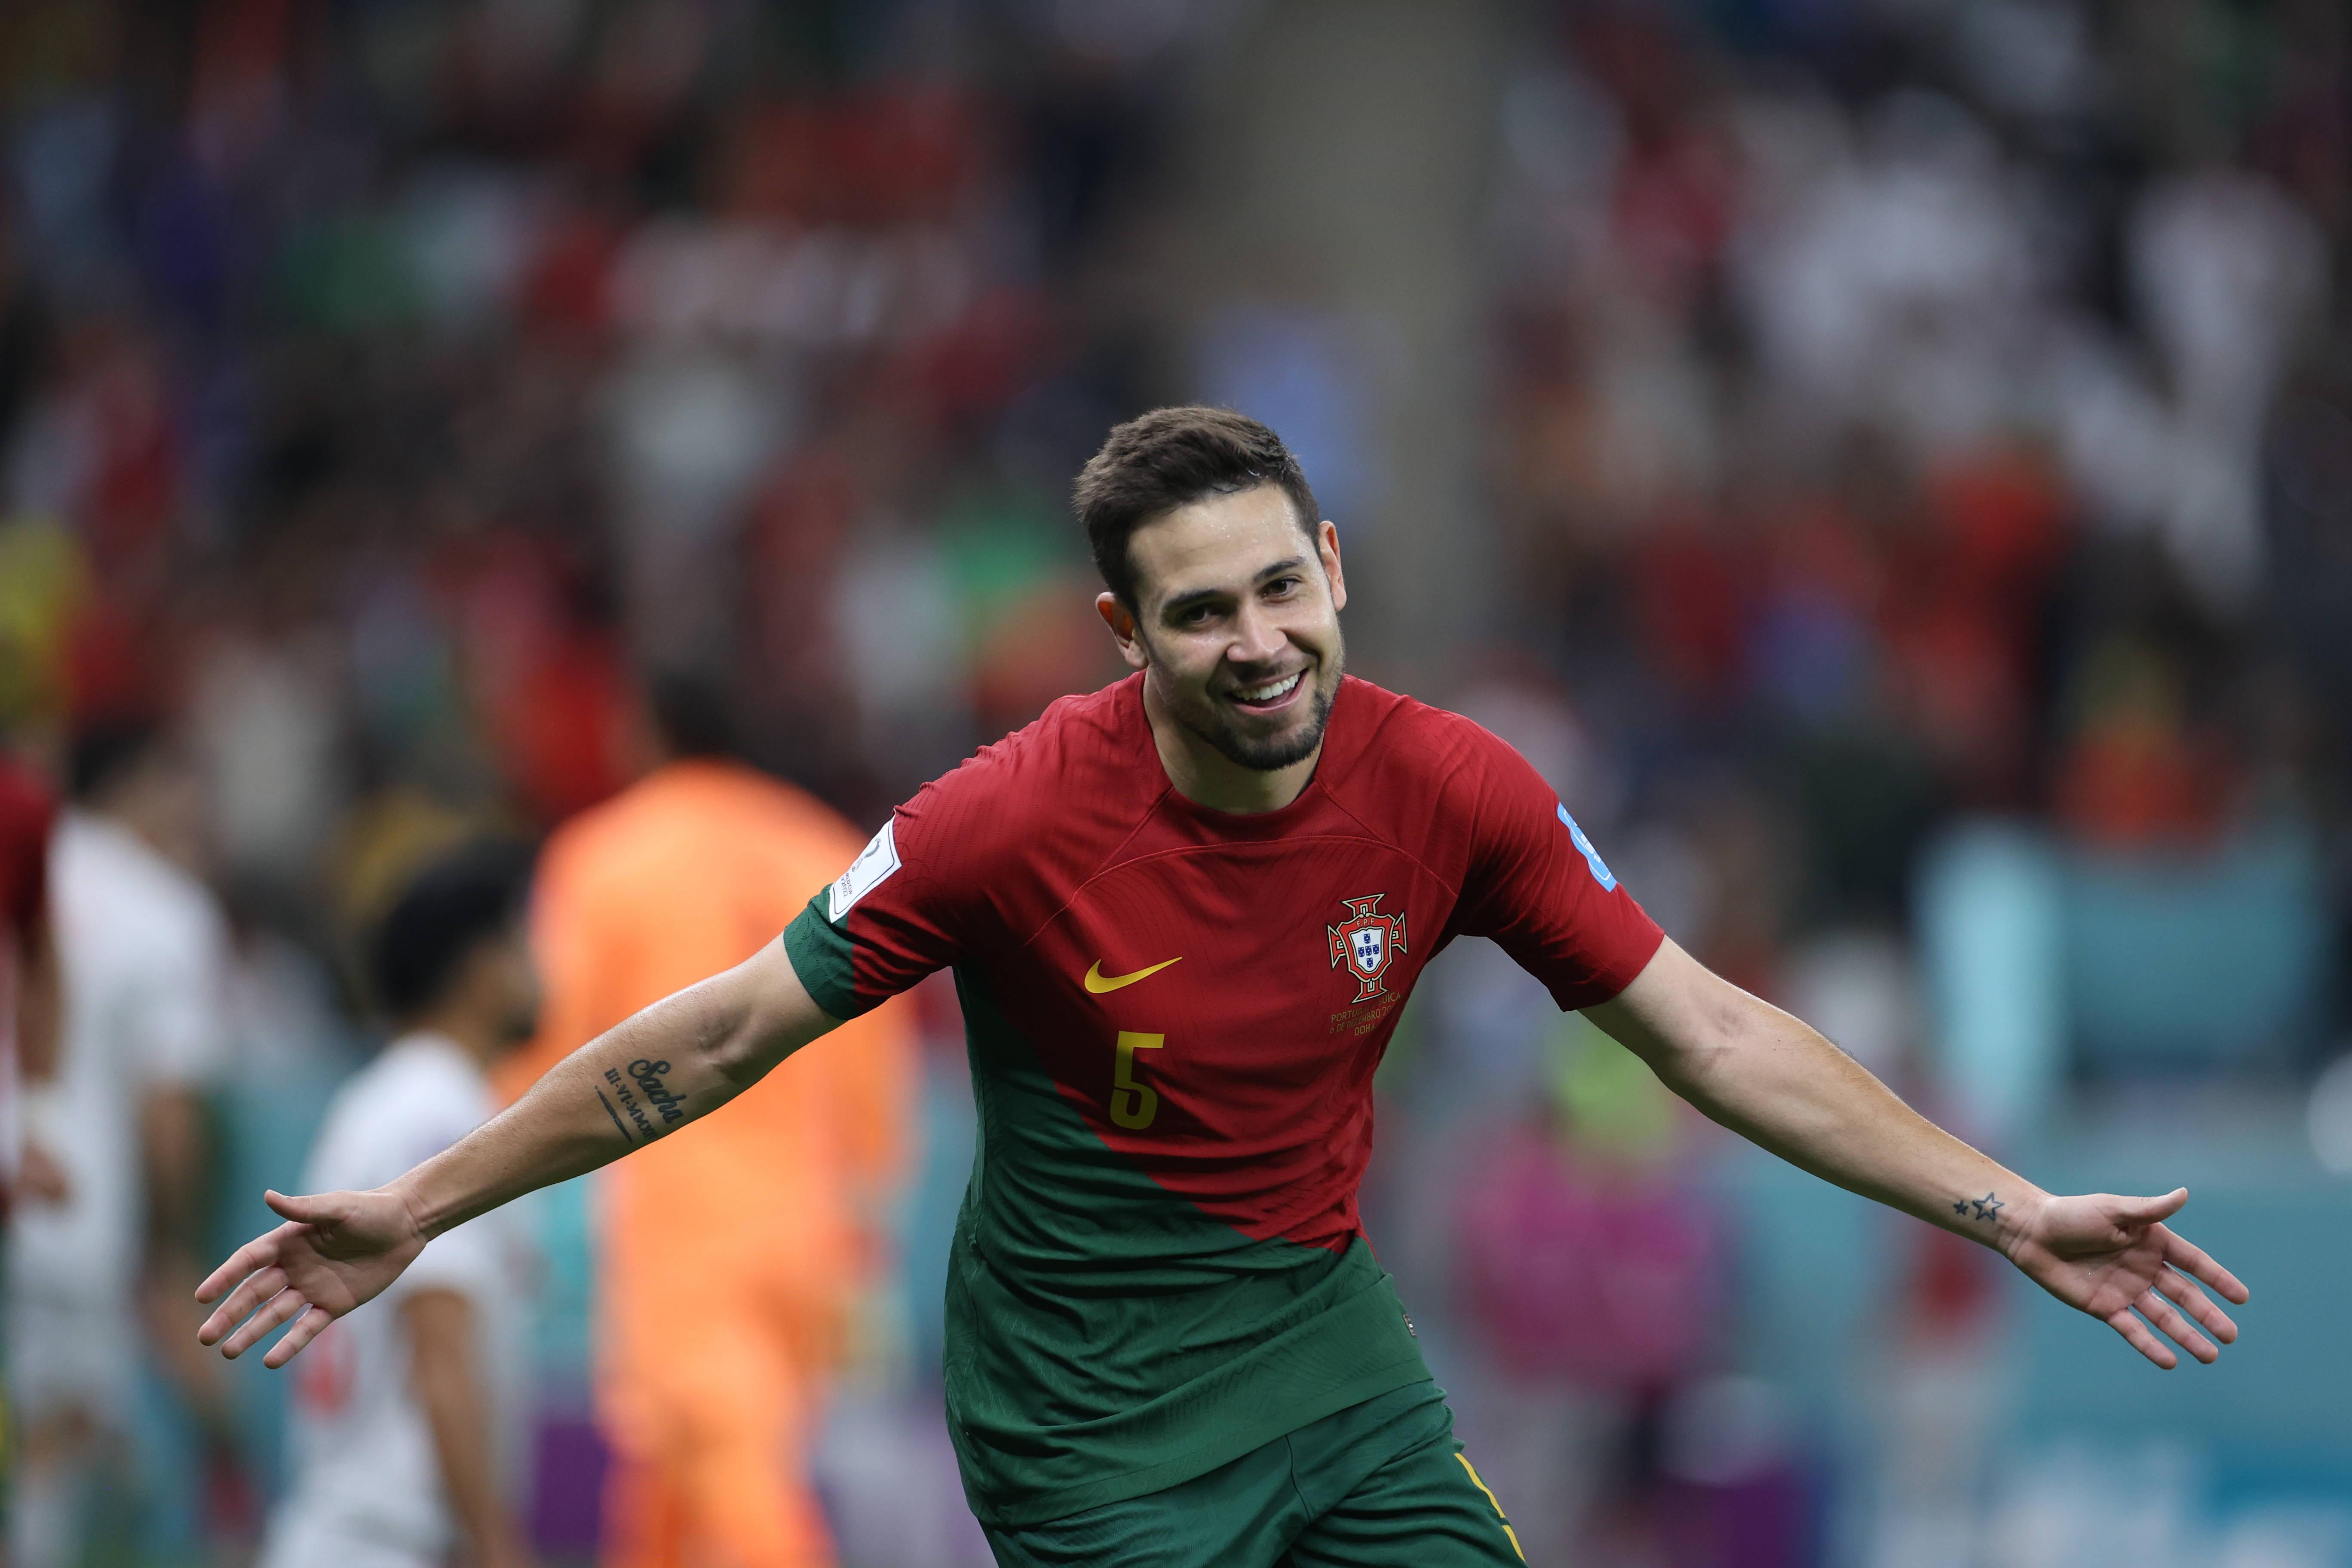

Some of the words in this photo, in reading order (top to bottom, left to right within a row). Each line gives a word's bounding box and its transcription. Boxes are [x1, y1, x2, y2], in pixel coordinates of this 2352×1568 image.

[1331, 1006, 1369, 1023] PORTUGA
[1336, 1022, 1345, 1032] DE
[1354, 1023, 1375, 1036] DOHA
[1110, 1030, 1165, 1130] 5
[628, 1059, 687, 1124] Sacha
